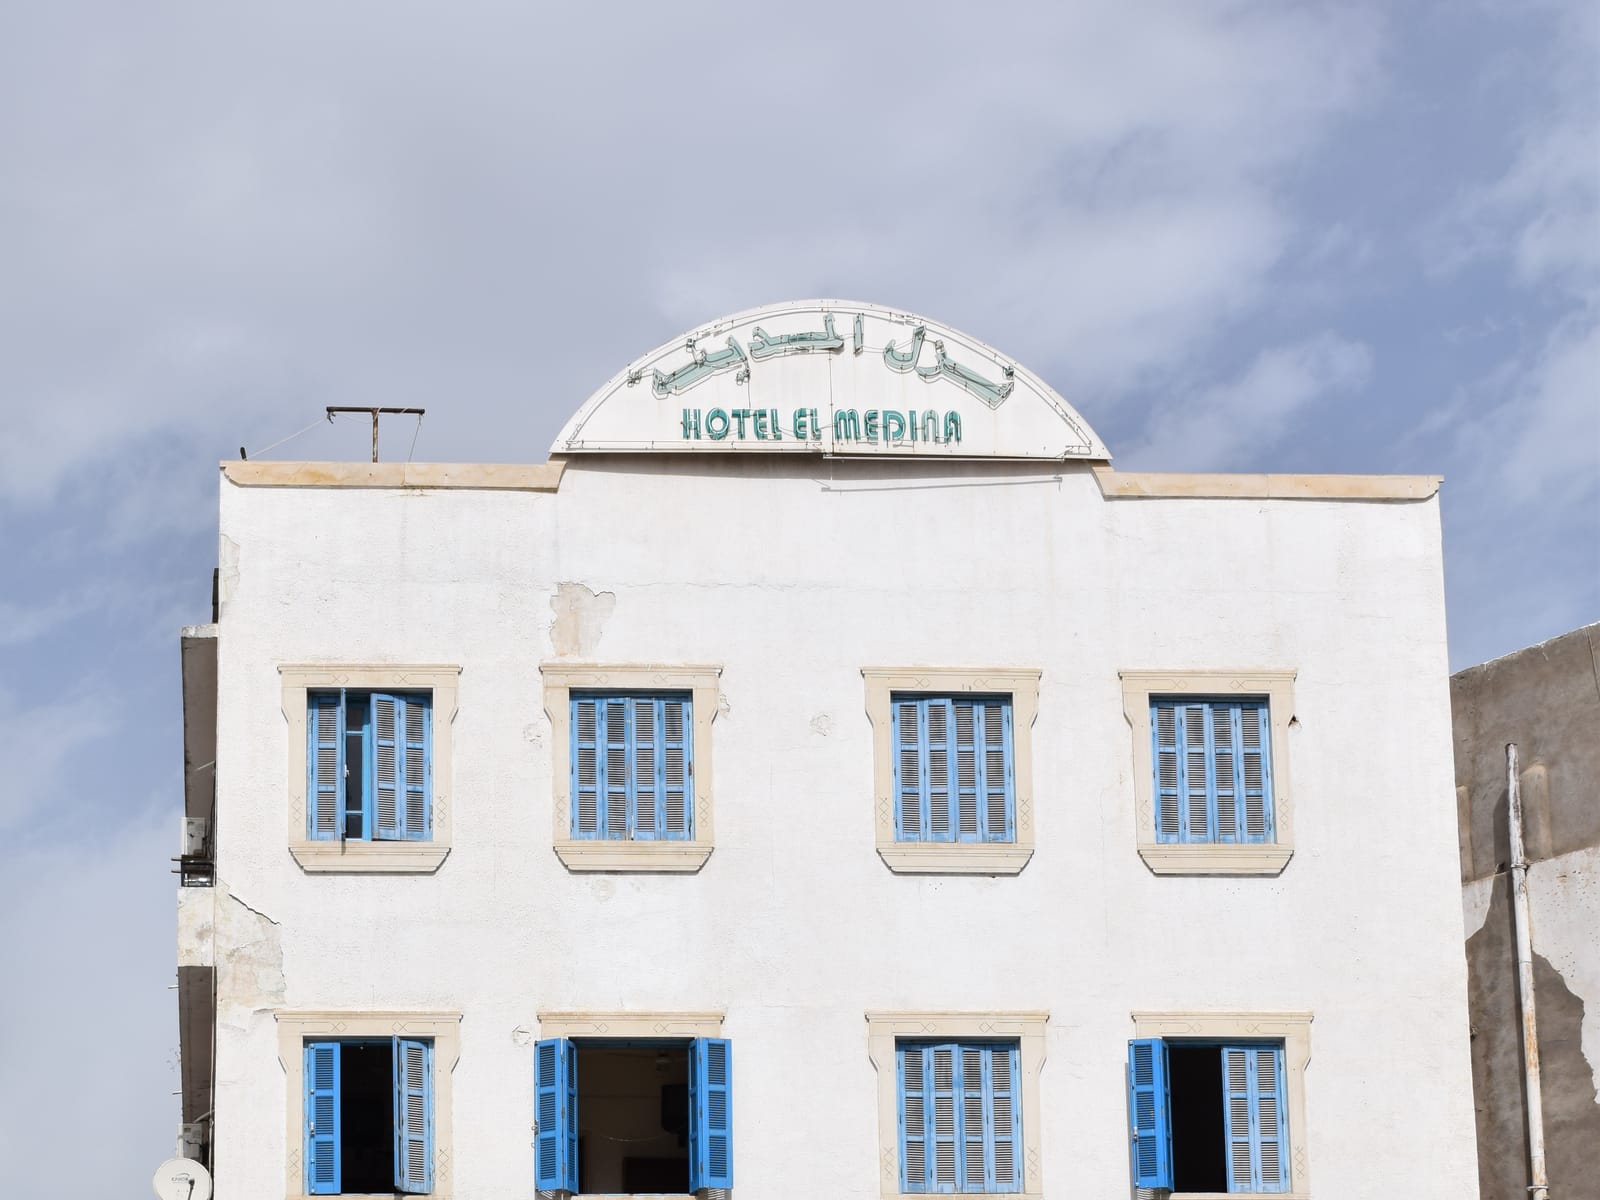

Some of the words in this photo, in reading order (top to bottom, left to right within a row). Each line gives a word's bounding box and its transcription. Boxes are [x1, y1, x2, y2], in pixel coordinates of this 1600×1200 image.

[682, 408, 782, 440] HOTEL
[793, 408, 822, 440] EL
[834, 409, 961, 442] MEDINA
